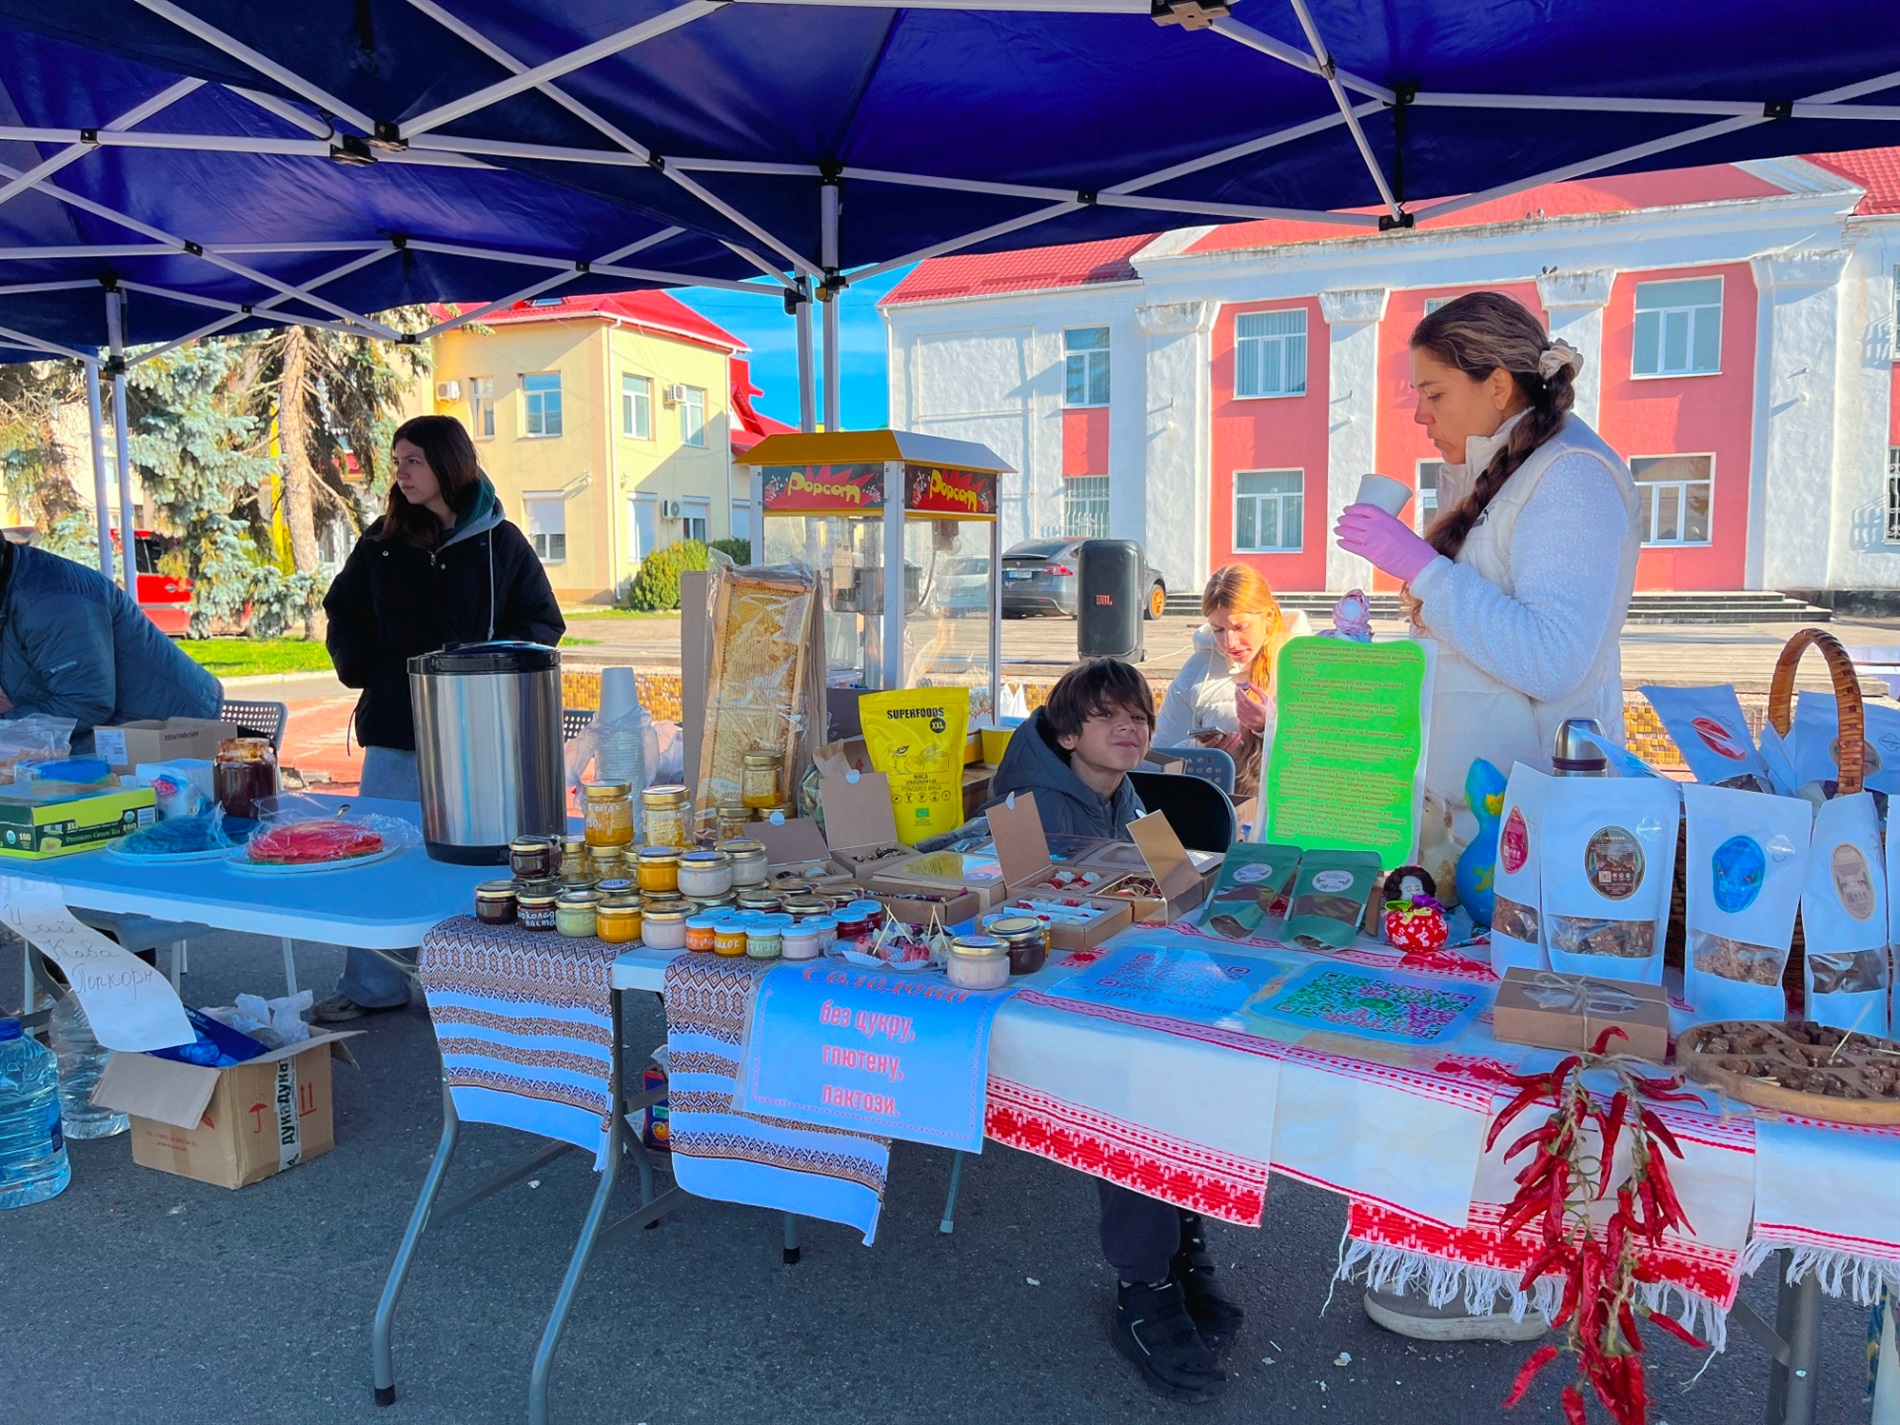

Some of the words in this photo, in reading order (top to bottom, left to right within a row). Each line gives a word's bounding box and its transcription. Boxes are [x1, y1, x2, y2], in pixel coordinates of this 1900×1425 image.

[787, 471, 861, 504] Popcorn
[929, 469, 978, 512] Popcorn
[1095, 594, 1113, 606] JBL
[887, 707, 945, 719] SUPERFOODS
[931, 721, 945, 730] XXL
[71, 963, 152, 1000] Попкорн
[820, 999, 852, 1027] без
[855, 1010, 915, 1042] цукру,
[822, 1045, 904, 1083] глютену,
[822, 1084, 900, 1117] лактози.
